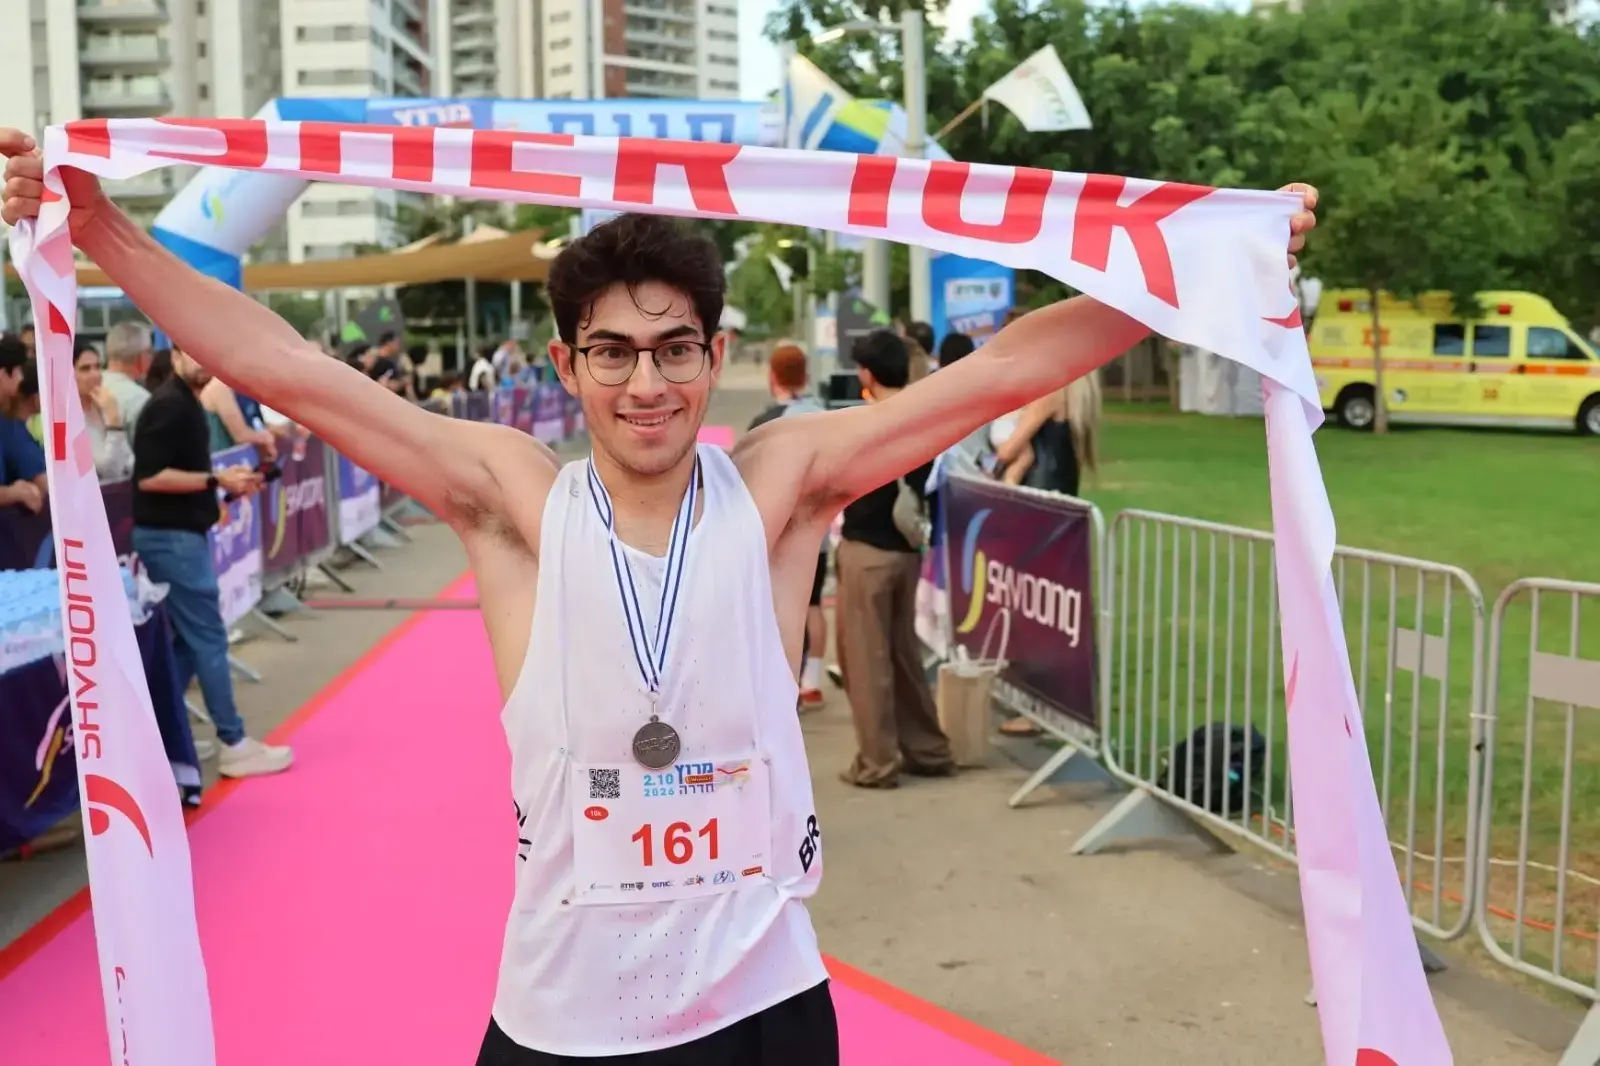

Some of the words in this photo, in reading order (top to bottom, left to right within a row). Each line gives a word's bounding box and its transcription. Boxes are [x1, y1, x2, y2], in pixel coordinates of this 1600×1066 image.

[847, 154, 1217, 309] 10K
[643, 773, 674, 786] 2.10
[675, 762, 714, 785] מרוץ
[643, 788, 675, 797] 2026
[679, 783, 715, 795] חדרה
[632, 817, 718, 867] 161
